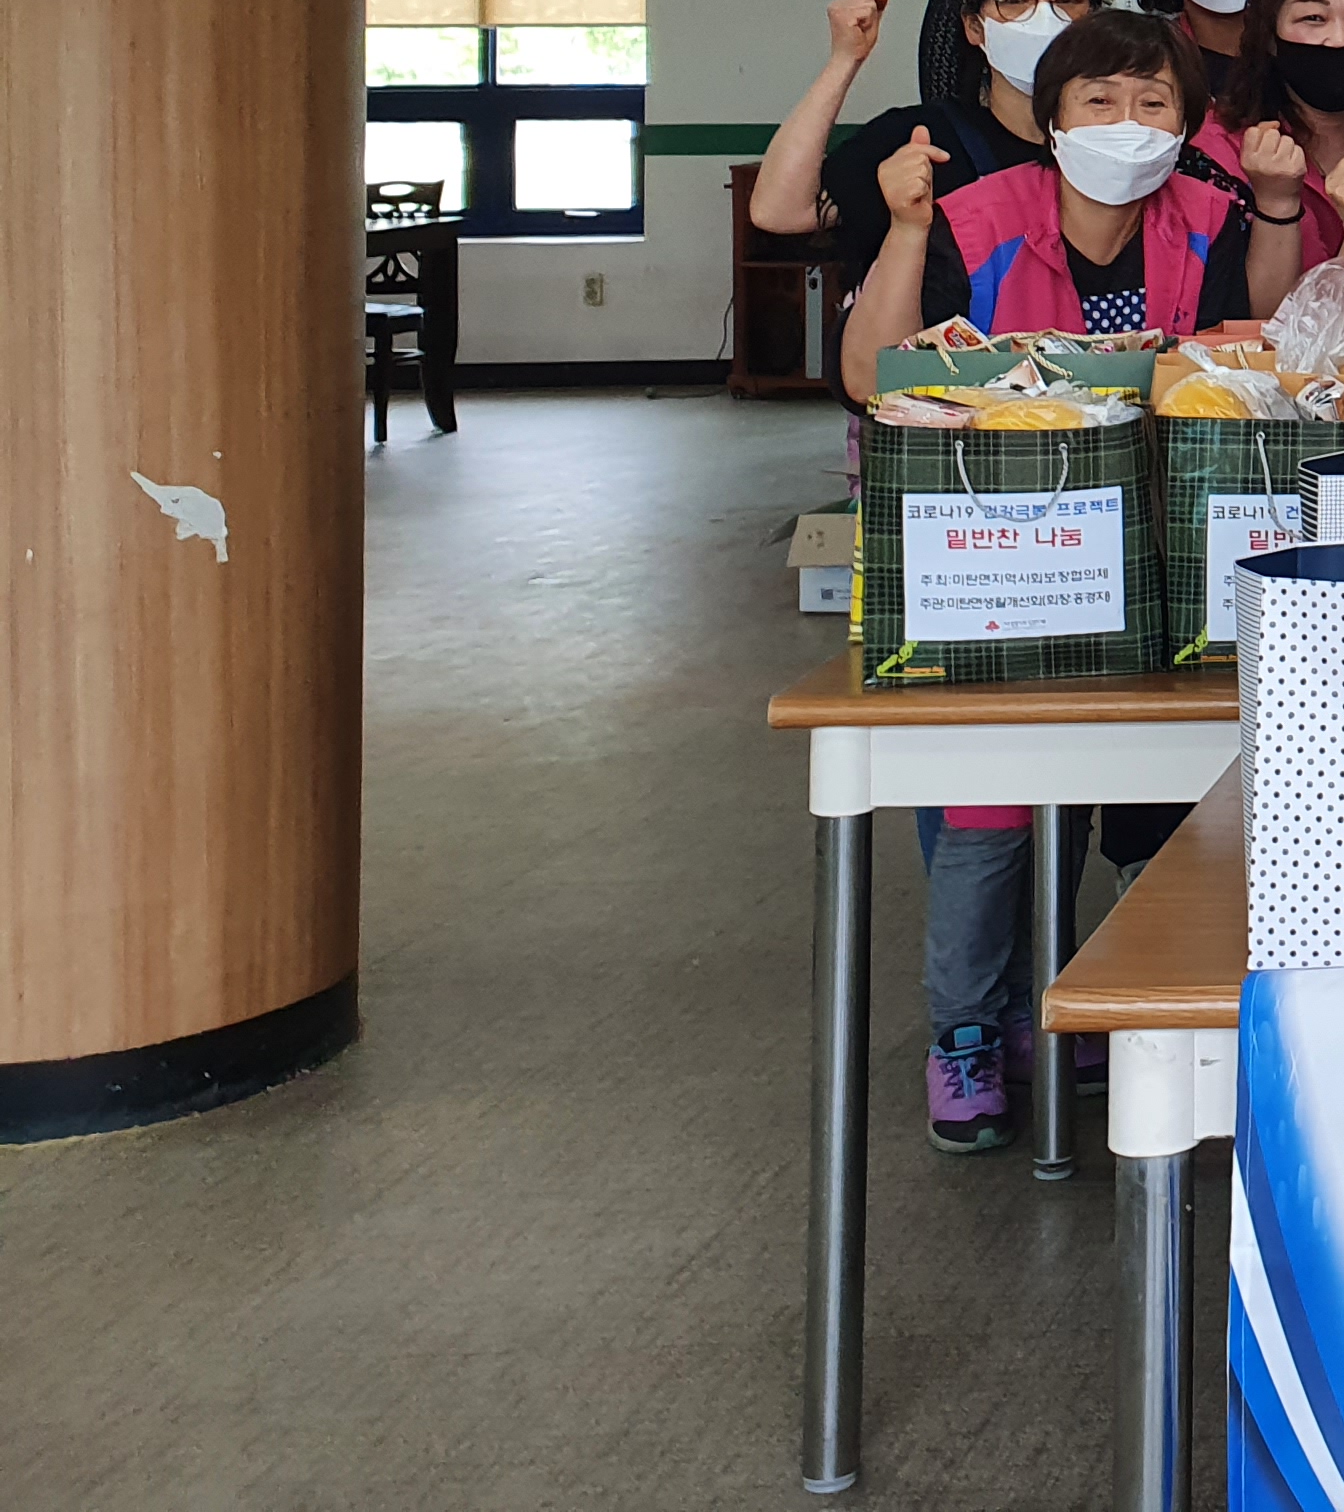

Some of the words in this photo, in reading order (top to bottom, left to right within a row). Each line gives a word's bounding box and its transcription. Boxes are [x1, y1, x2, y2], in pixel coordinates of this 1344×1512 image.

[908, 505, 974, 520] 코로나19
[1056, 498, 1119, 517] 프로젝트
[947, 528, 1019, 549] 밑반찬
[1035, 527, 1081, 547] 나눔
